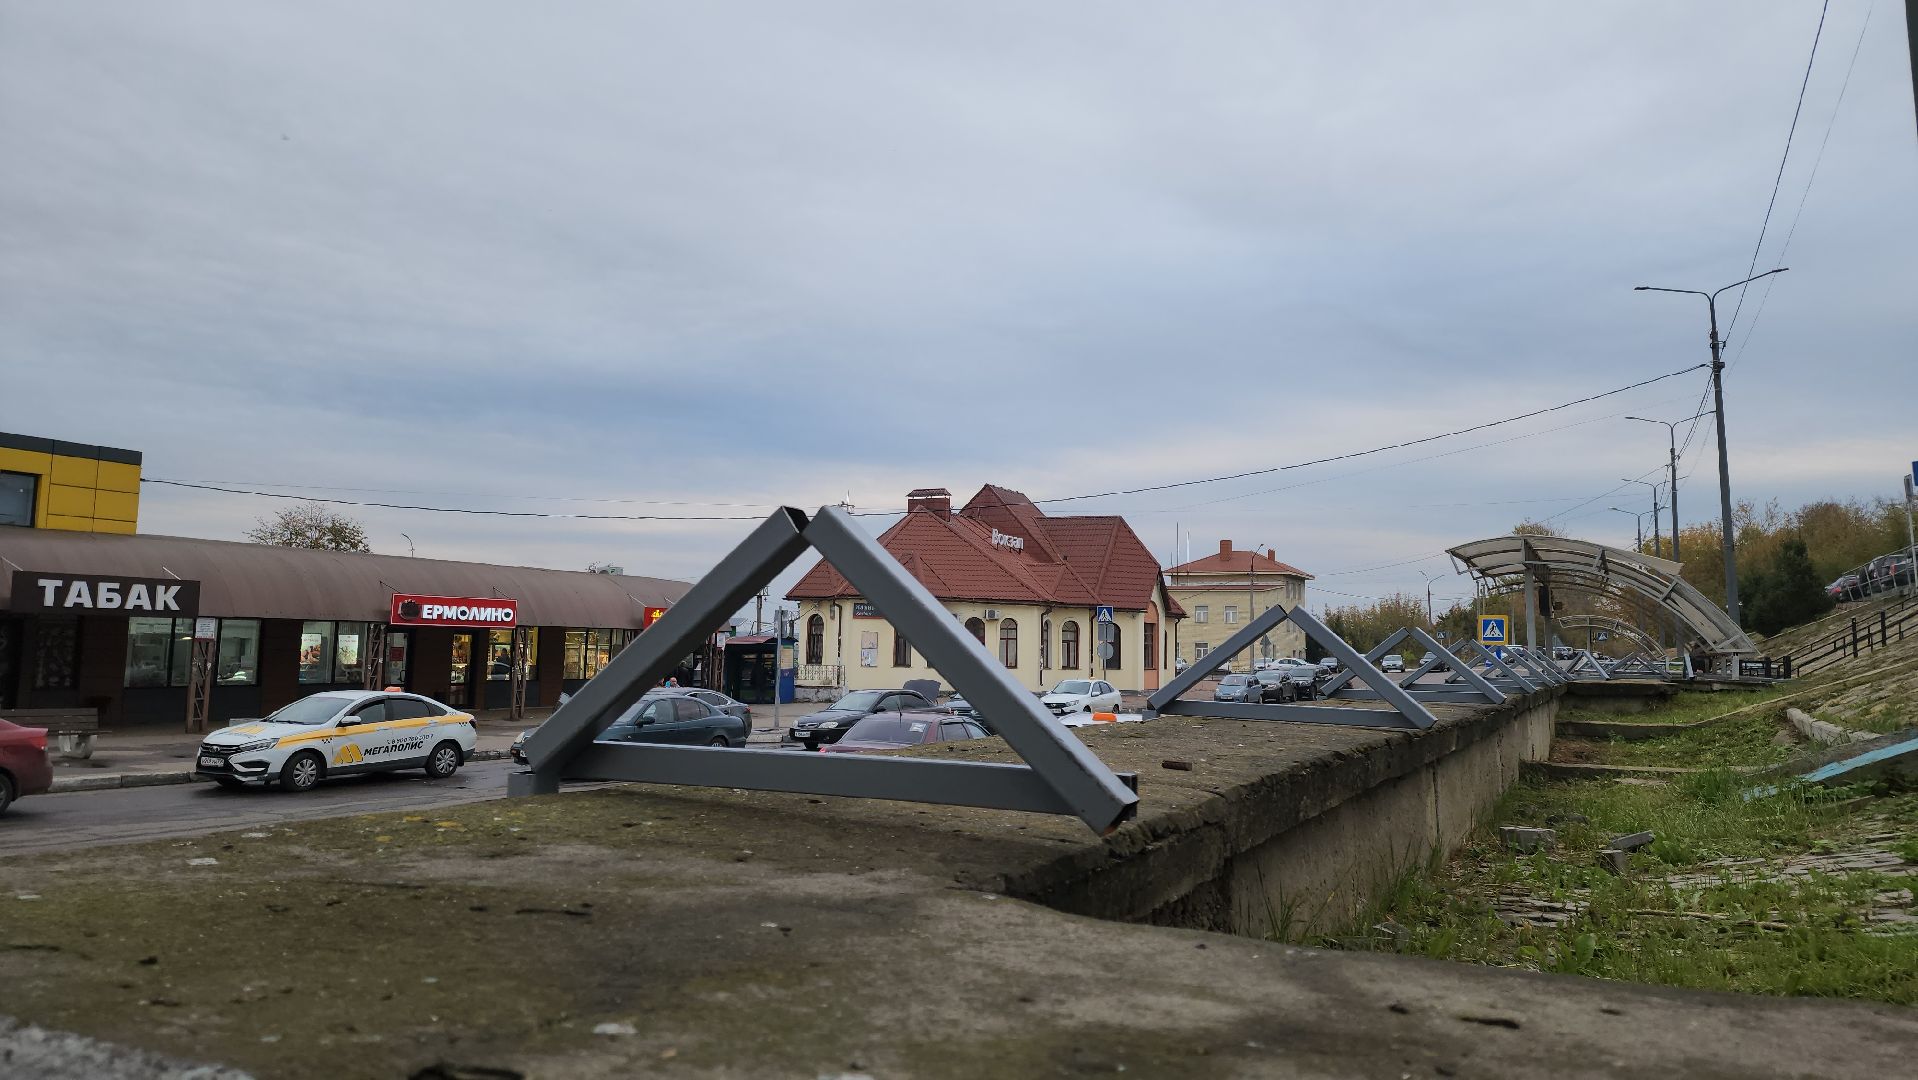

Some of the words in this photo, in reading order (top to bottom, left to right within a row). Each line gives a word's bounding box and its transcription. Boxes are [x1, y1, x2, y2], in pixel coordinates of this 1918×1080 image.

[991, 528, 1024, 550] Вокзал
[38, 578, 182, 611] ТАБАК
[421, 604, 514, 622] ЕРМОЛИНО
[363, 740, 424, 757] МЕГАПОЛИС
